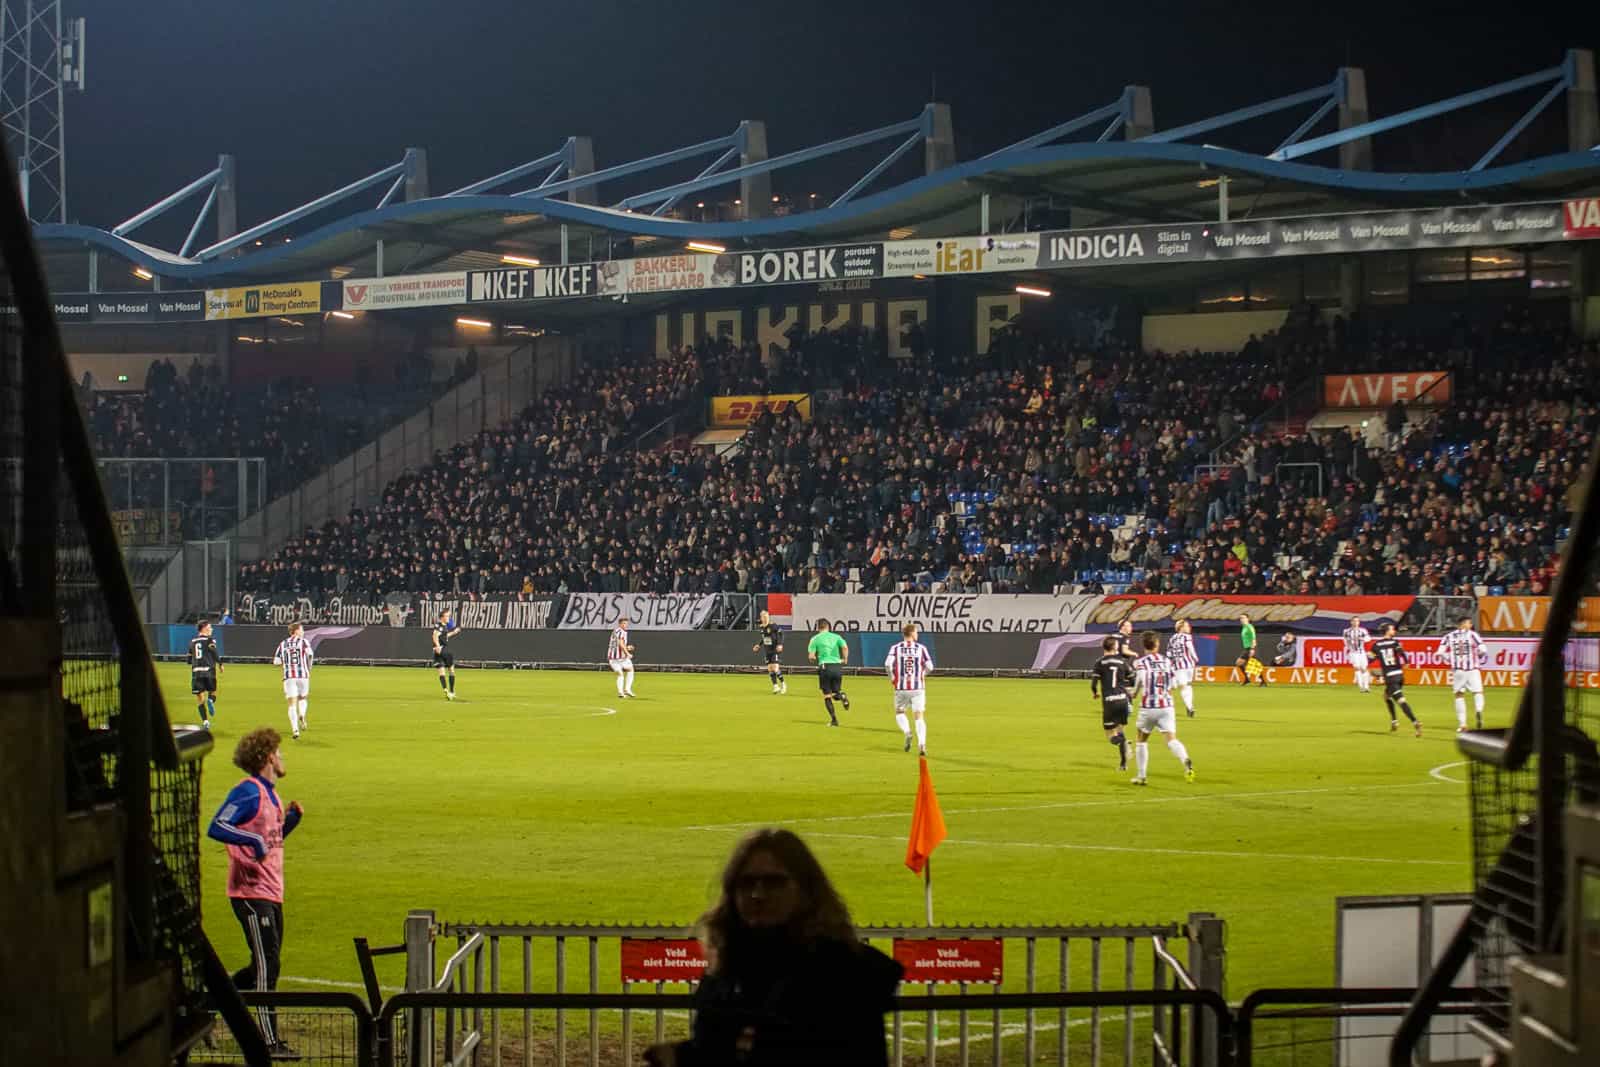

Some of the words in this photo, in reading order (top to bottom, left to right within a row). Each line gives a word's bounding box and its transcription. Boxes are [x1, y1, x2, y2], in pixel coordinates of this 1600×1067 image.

[1350, 225, 1371, 238] Van
[1373, 223, 1410, 237] Mossel
[1421, 223, 1441, 235] Van
[1443, 220, 1481, 234] Mossel
[1492, 219, 1513, 231] Van
[1515, 216, 1555, 230] Mossel
[1157, 231, 1178, 243] Slim
[1180, 231, 1191, 241] in
[1214, 235, 1233, 247] Van
[1235, 231, 1270, 246] Mossel
[1282, 231, 1302, 242] Van
[1303, 227, 1339, 241] Mossel
[1050, 233, 1144, 261] INDICIA
[1157, 243, 1189, 256] digital
[634, 255, 697, 275] BAKKERIJ
[741, 248, 837, 284] BOREK
[844, 258, 871, 267] outdoor
[844, 267, 874, 277] furniture
[423, 278, 465, 290] TRANSPORT
[262, 288, 302, 299] McDonald's
[55, 304, 89, 314] Mossel
[98, 304, 115, 313] Van
[117, 304, 149, 313] Mossel
[159, 303, 173, 312] Van
[175, 301, 200, 312] Mossel
[262, 302, 287, 313] Tilburg
[1337, 373, 1435, 406] AVEC
[566, 594, 620, 627] BRAS
[876, 594, 977, 618] LONNEKE
[460, 600, 503, 629] BRISTOL
[194, 642, 203, 659] 6
[1380, 648, 1396, 667] 14
[1109, 666, 1118, 688] 7
[1194, 667, 1216, 681] EC
[1290, 667, 1338, 684] AVEC
[1420, 670, 1454, 685] AVE
[1564, 672, 1600, 688] VEC
[664, 947, 687, 958] Veld
[936, 947, 959, 958] Veld
[643, 958, 663, 967] niet
[664, 958, 709, 968] betreden
[915, 958, 935, 968] niet
[936, 958, 981, 968] betreden
